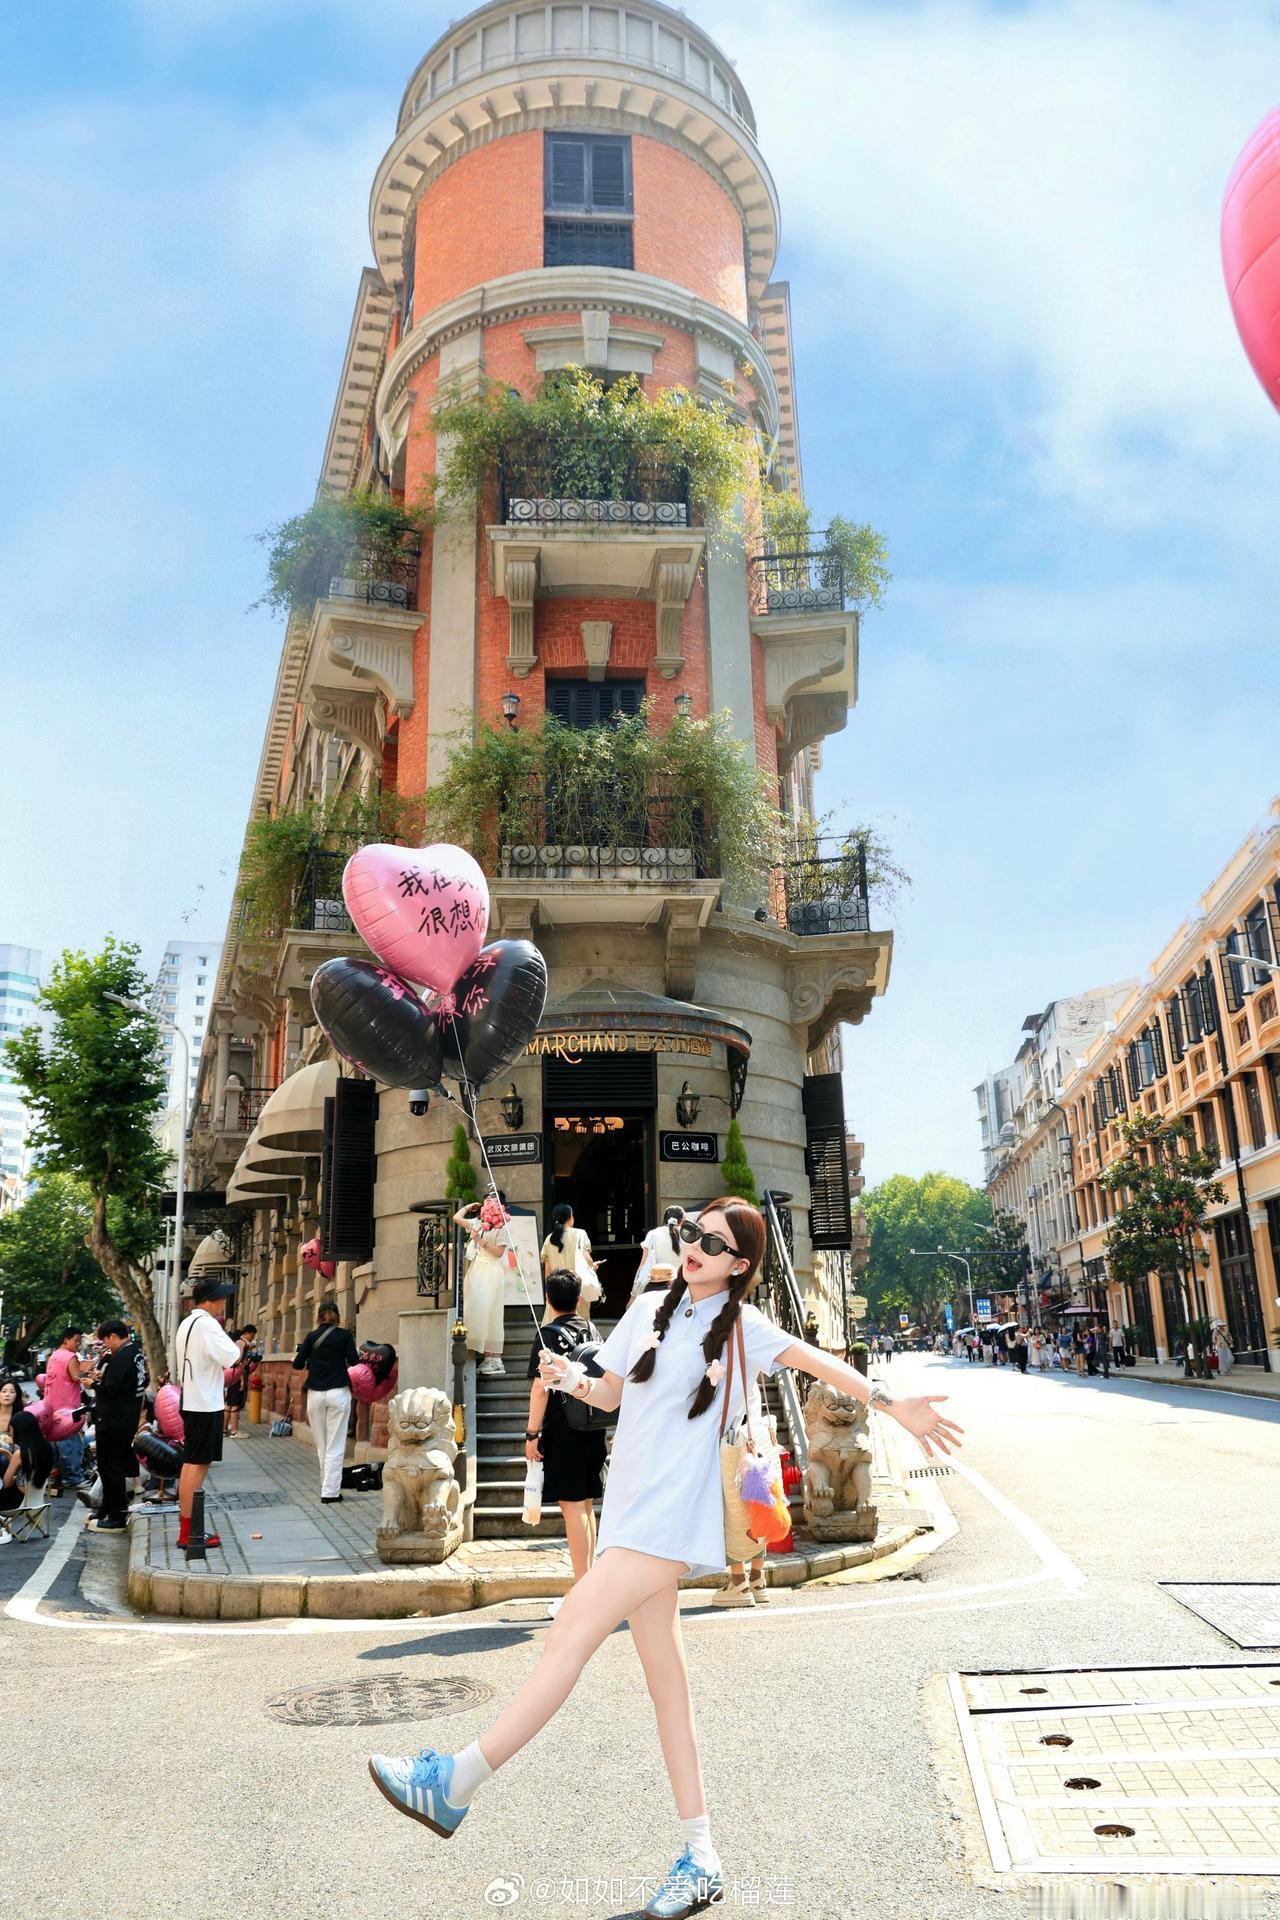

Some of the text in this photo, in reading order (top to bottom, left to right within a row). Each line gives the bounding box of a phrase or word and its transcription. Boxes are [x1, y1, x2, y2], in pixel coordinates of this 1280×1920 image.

[525, 1033, 712, 1064] MARCHAND 巴公小酒馆
[671, 1141, 709, 1152] 巴公咖啡
